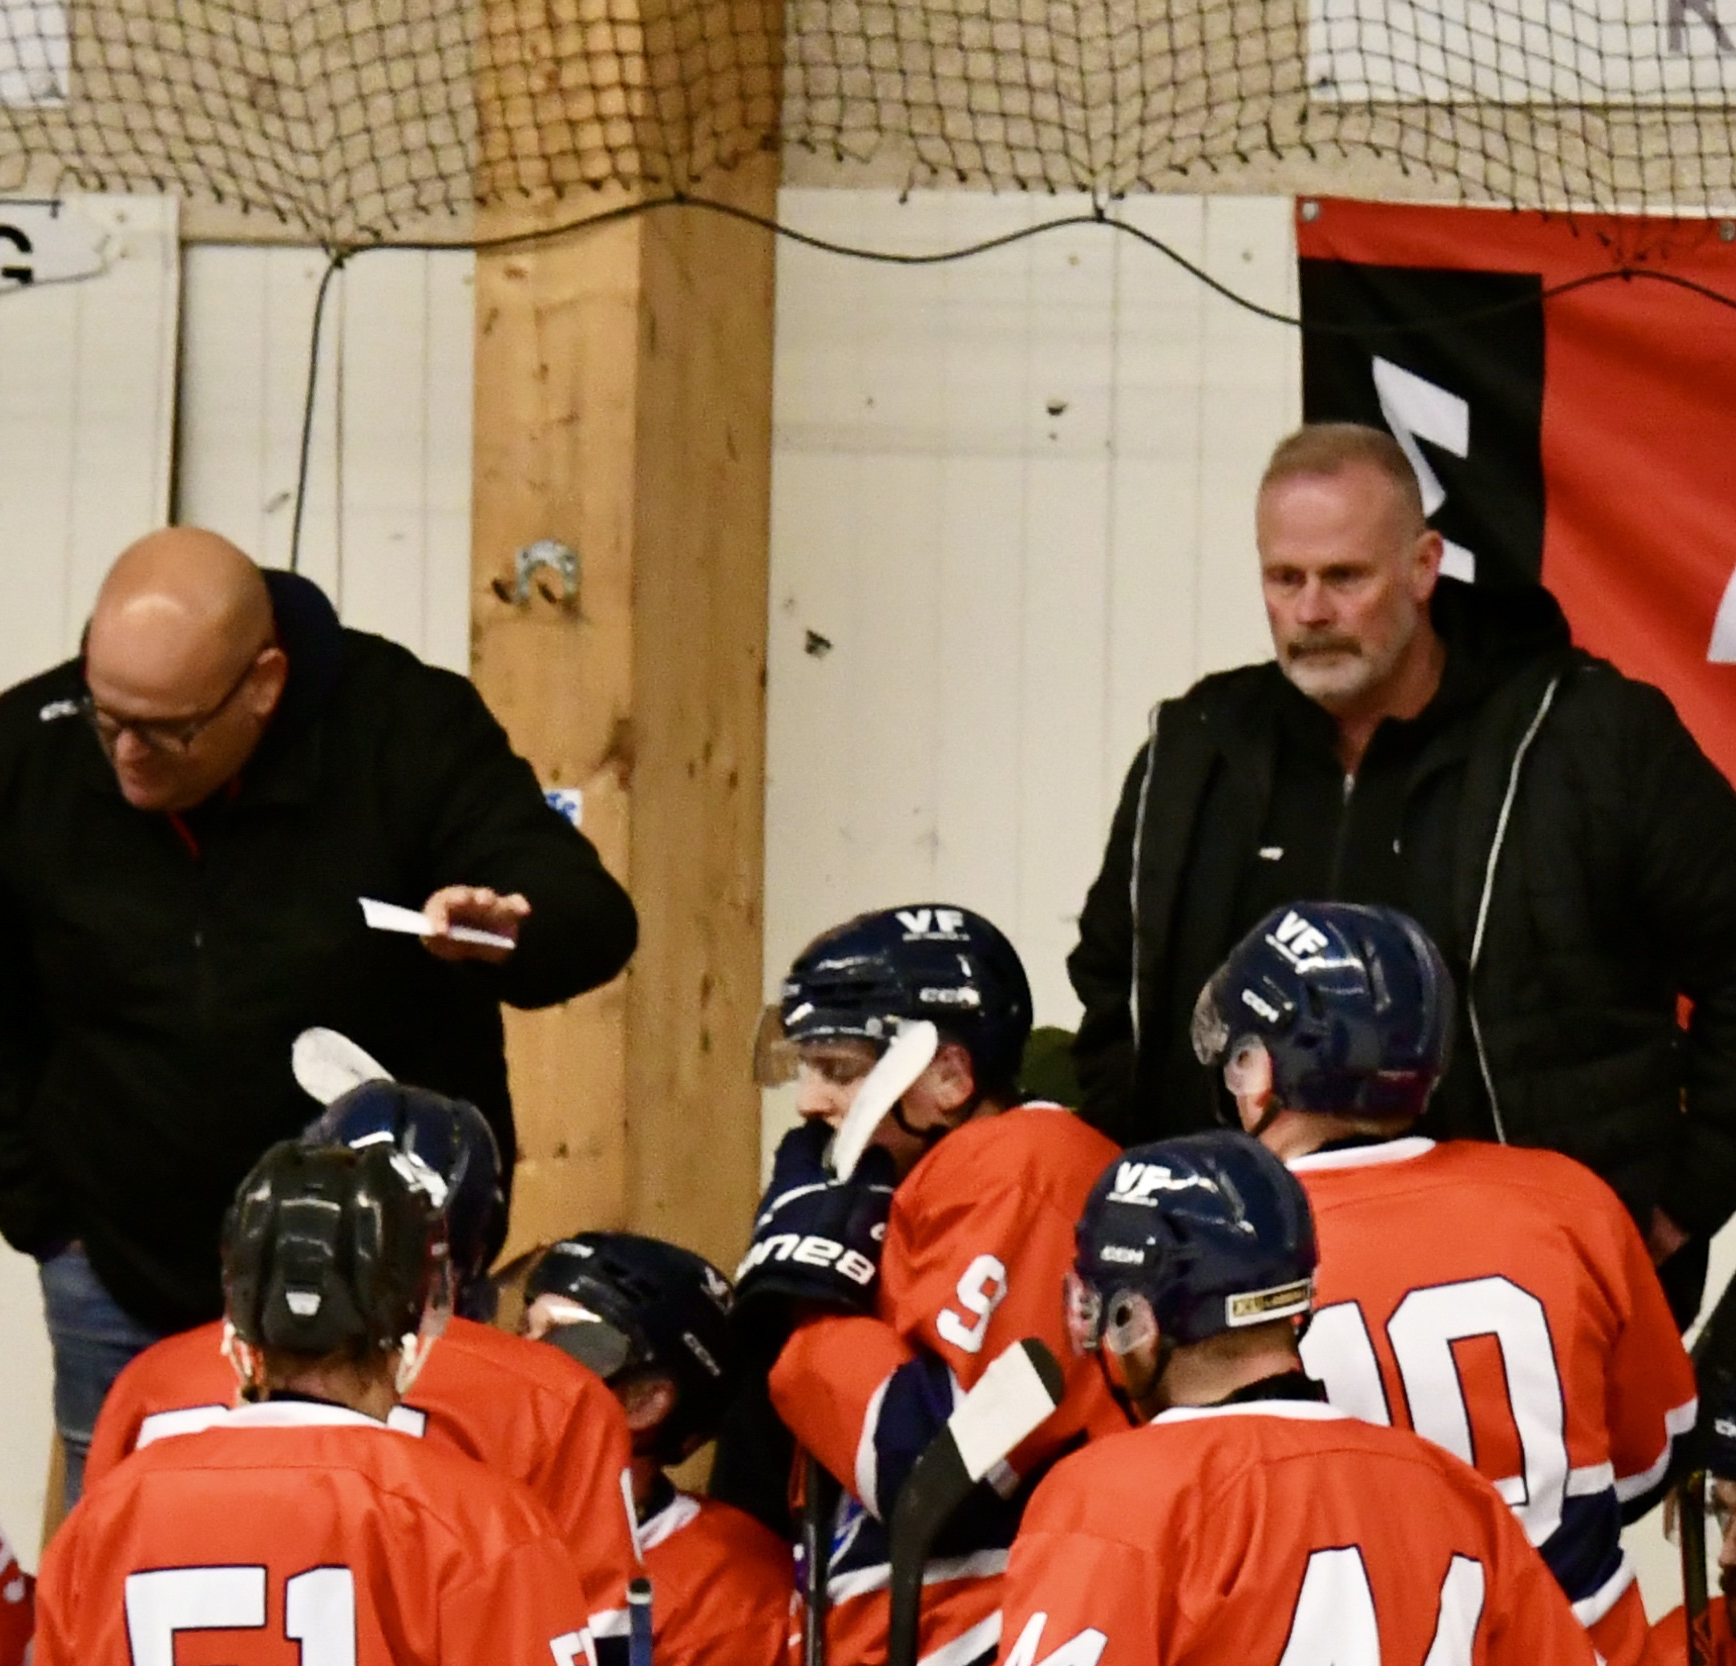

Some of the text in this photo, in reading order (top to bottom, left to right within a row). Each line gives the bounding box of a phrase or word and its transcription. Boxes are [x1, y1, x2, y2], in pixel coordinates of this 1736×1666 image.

[896, 909, 965, 936] VF
[1273, 910, 1329, 957] VF
[1113, 1161, 1174, 1199] VF
[935, 1253, 1008, 1353] 9
